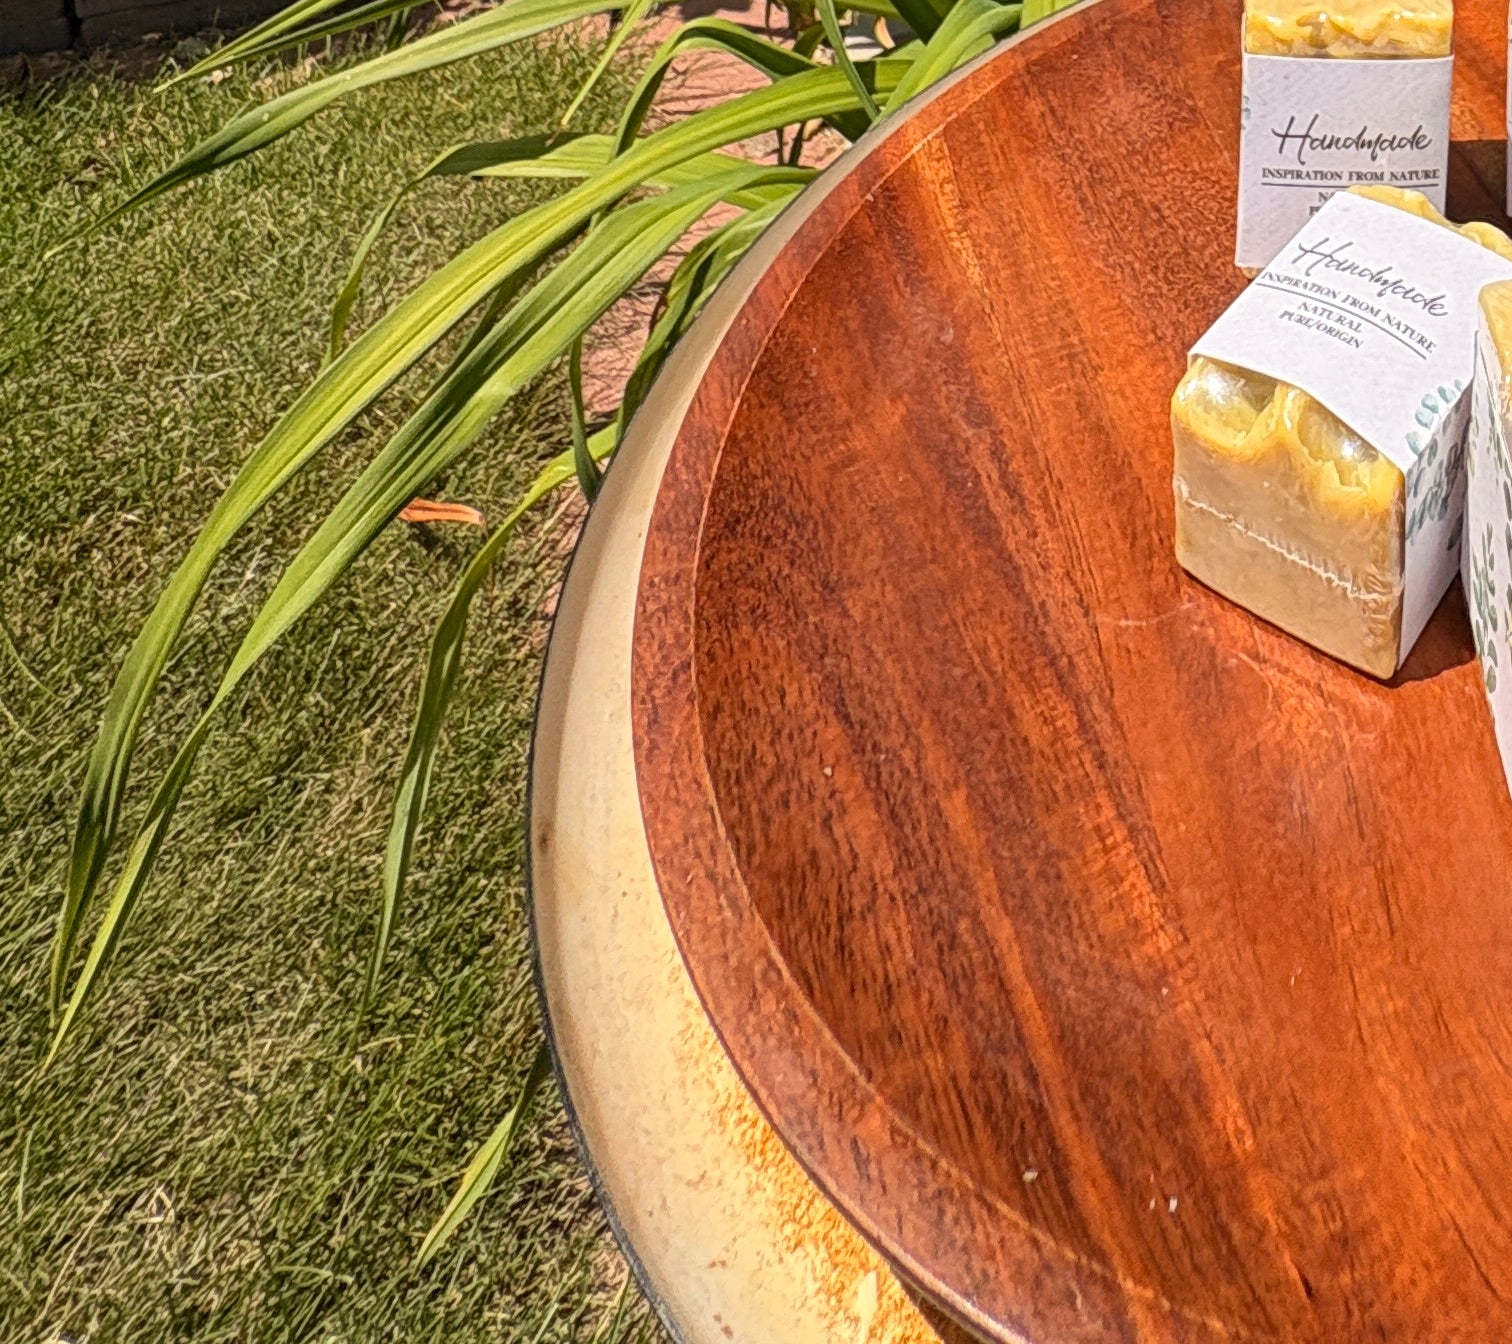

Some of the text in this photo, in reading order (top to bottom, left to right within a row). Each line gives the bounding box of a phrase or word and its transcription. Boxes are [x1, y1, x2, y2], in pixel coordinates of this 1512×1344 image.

[1271, 113, 1432, 165] Handmade
[1262, 167, 1440, 181] INSPIRATION FROM NATURE
[1291, 237, 1448, 317] Handmade
[1261, 271, 1437, 354] INSPIRATION FROM NATURE
[1279, 310, 1364, 349] PURE/ORIGIN
[1298, 300, 1363, 334] NATURAL
